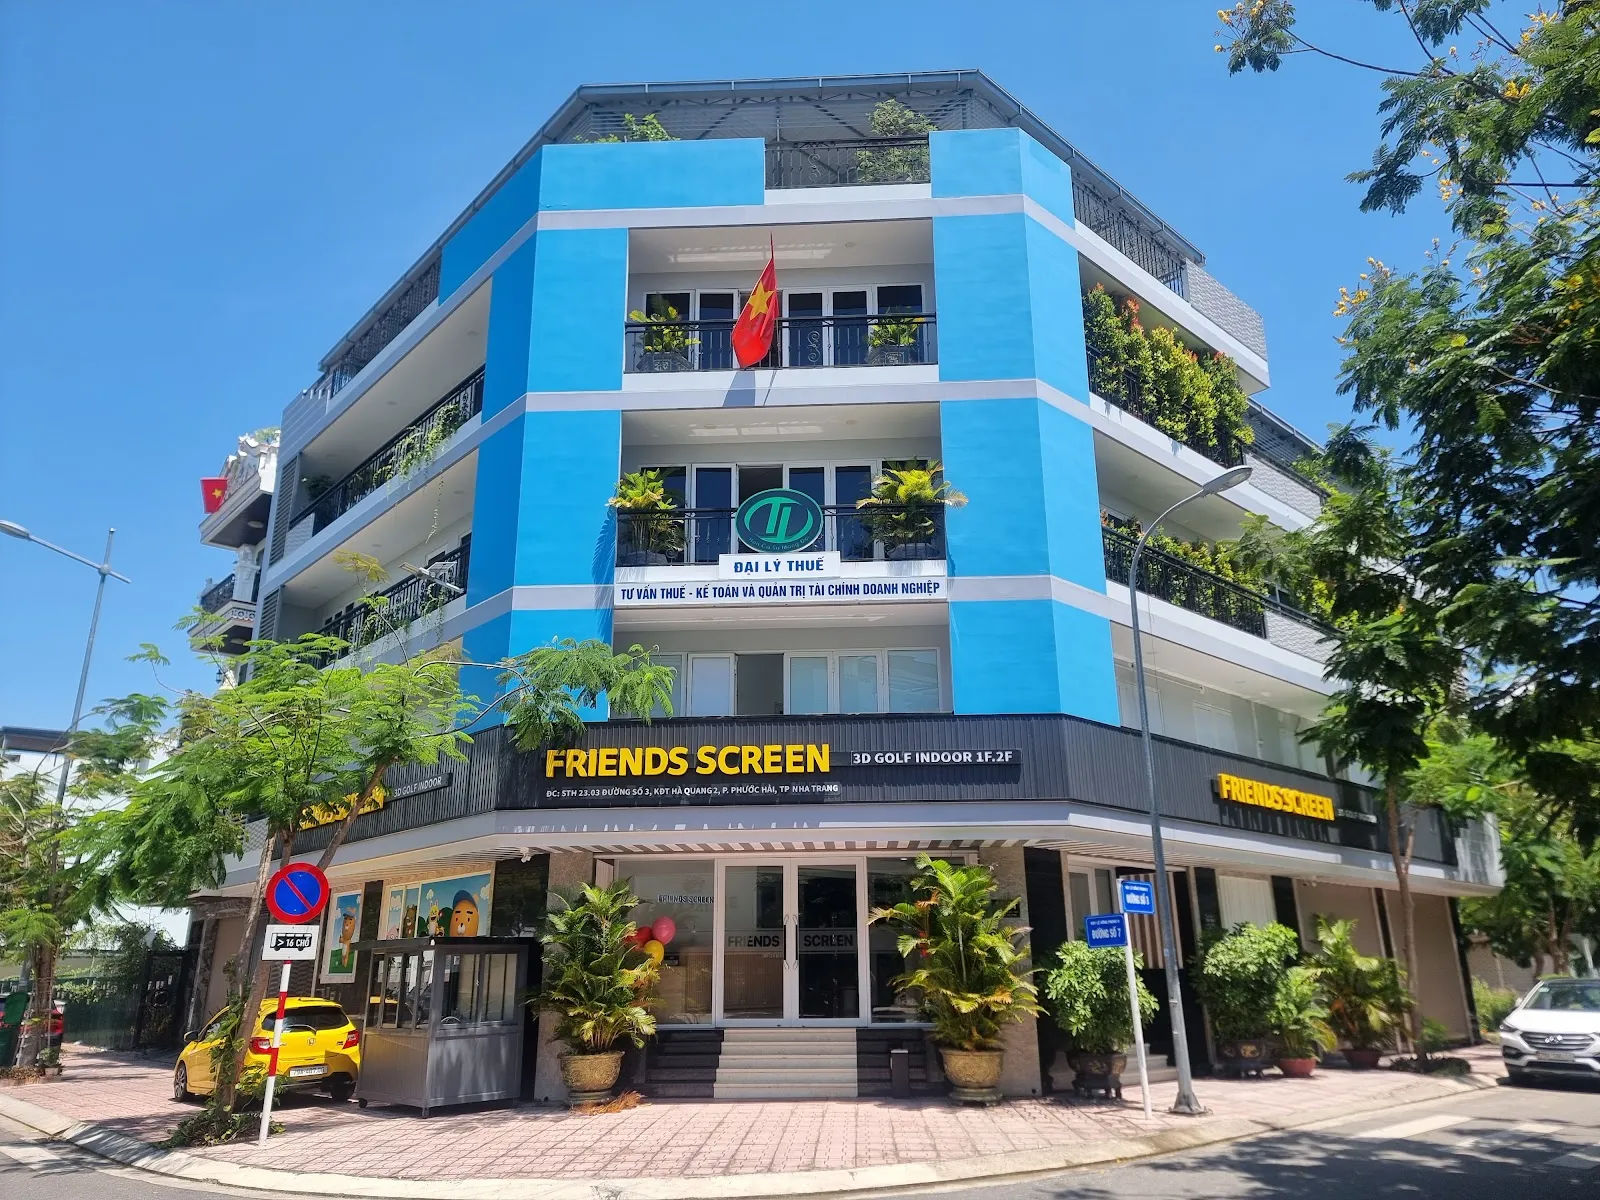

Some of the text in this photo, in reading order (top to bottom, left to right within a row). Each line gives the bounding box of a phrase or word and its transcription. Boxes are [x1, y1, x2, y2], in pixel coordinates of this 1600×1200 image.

[733, 556, 825, 576] ĐẠI LÝ THUẾ
[621, 587, 635, 600] TƯ
[636, 584, 657, 600] VẤN
[660, 584, 687, 599] THUẾ
[695, 583, 710, 599] KẾ
[712, 585, 739, 598] TOÁN
[742, 583, 756, 598] VÀ
[758, 581, 787, 598] QUẢN
[790, 584, 806, 599] TRỊ
[808, 583, 825, 597] TÀI
[827, 581, 860, 596] CHÍNH
[863, 582, 899, 596] DOANH
[901, 579, 940, 597] NGHIỆP
[545, 743, 831, 778] FRIENDS SCREEN
[853, 750, 1013, 765] 3D GOLF INDOOR 1F.2F
[402, 782, 418, 796] GOLF
[418, 776, 442, 791] INDOOR
[546, 789, 560, 798] ĐC:
[561, 787, 577, 797] STH
[578, 788, 600, 797] 23.03
[601, 785, 631, 796] ĐƯỜNG
[632, 786, 644, 796] SỐ
[644, 787, 653, 797] 3,
[653, 786, 671, 796] KĐT
[671, 785, 683, 795] HÀ
[722, 786, 729, 795] P.
[731, 784, 760, 794] PHƯỚC
[761, 784, 778, 795] HẢI,
[779, 785, 790, 793] TP
[792, 785, 810, 793] NHA
[811, 784, 839, 793] TRANG
[1091, 925, 1121, 940] ĐƯỜNG SỐ 7
[286, 938, 295, 948] 16
[727, 934, 854, 948] FRIENDS SCREEN
